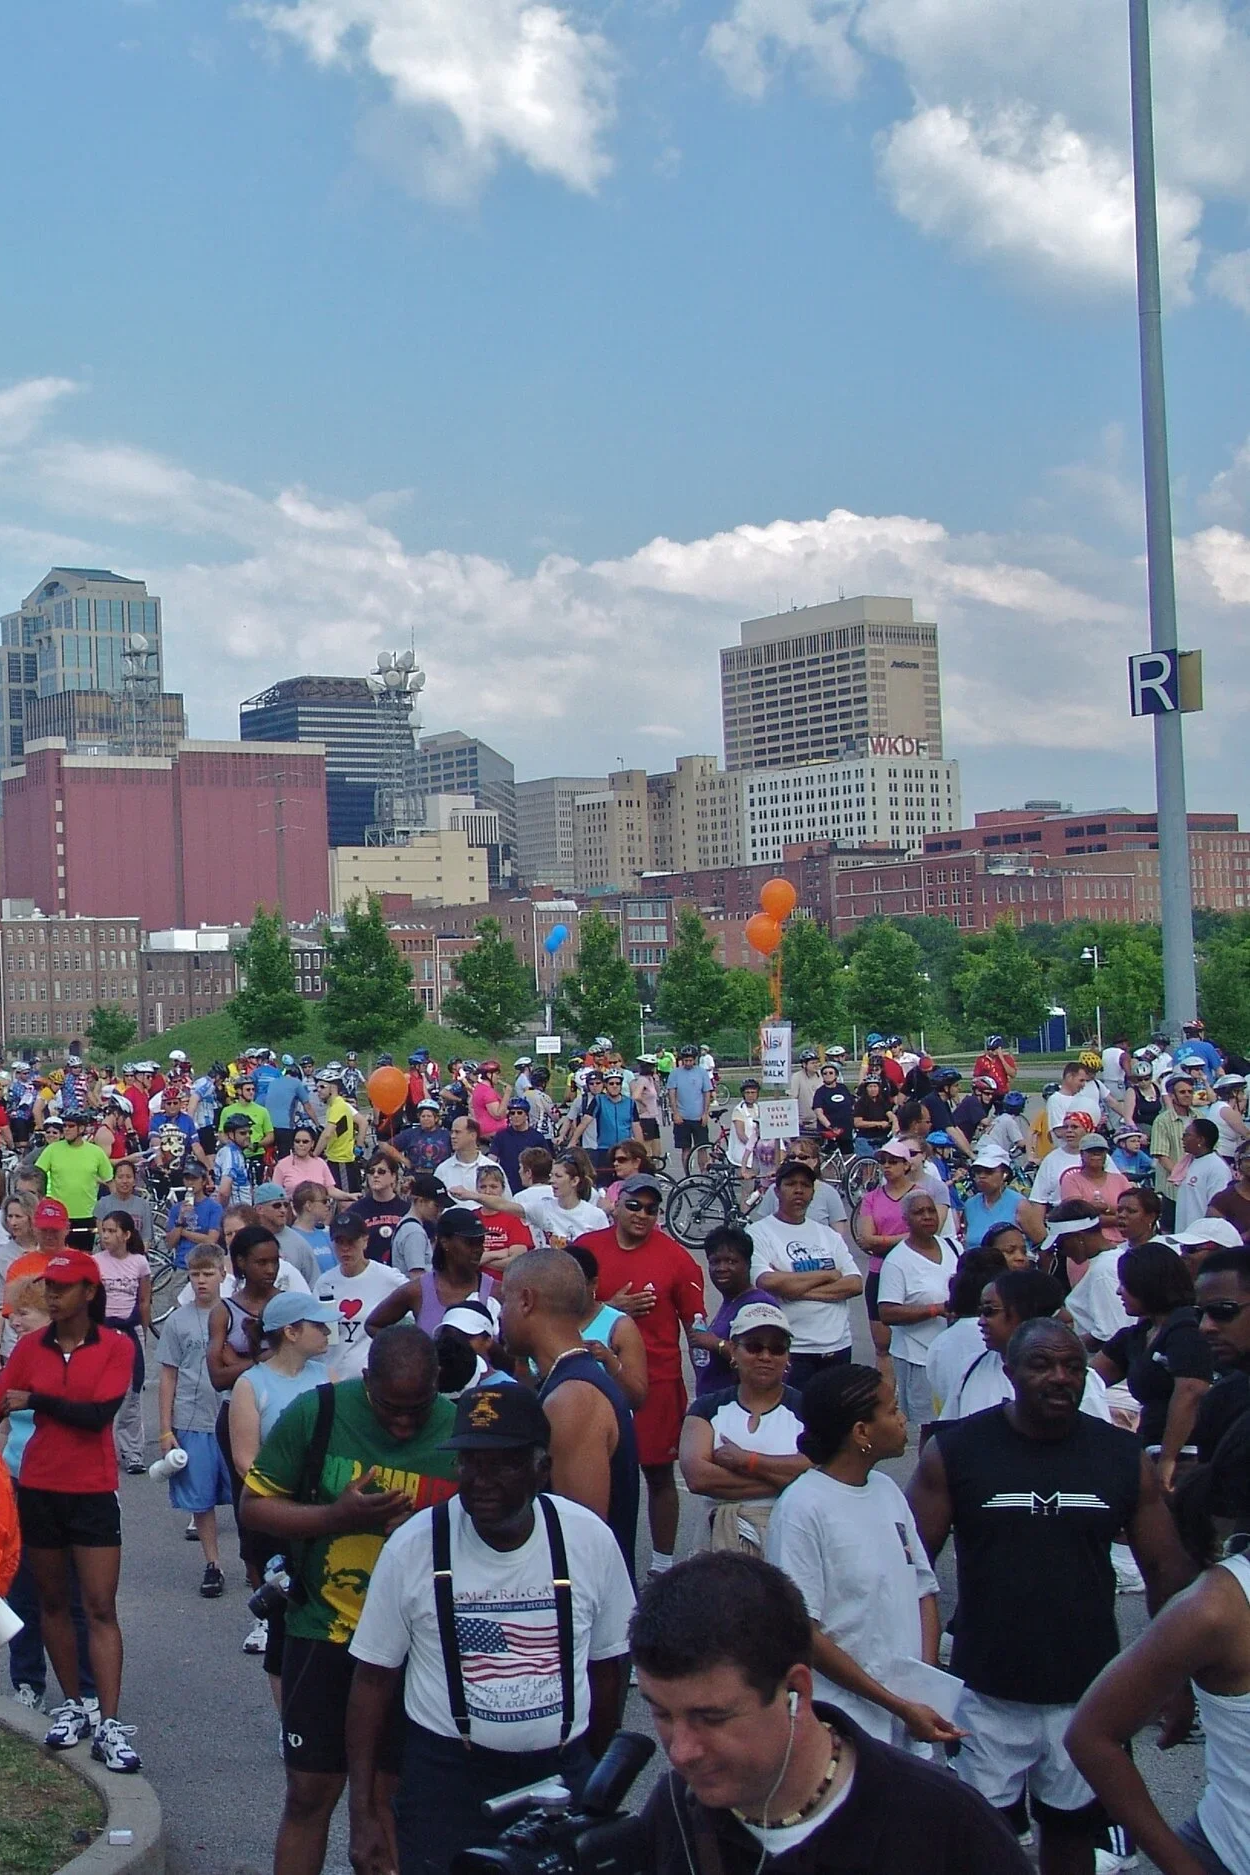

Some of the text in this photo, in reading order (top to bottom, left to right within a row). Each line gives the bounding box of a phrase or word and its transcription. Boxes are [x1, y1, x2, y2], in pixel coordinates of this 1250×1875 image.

[1133, 652, 1175, 715] R
[870, 735, 929, 757] WKDF
[763, 1070, 785, 1078] WALK
